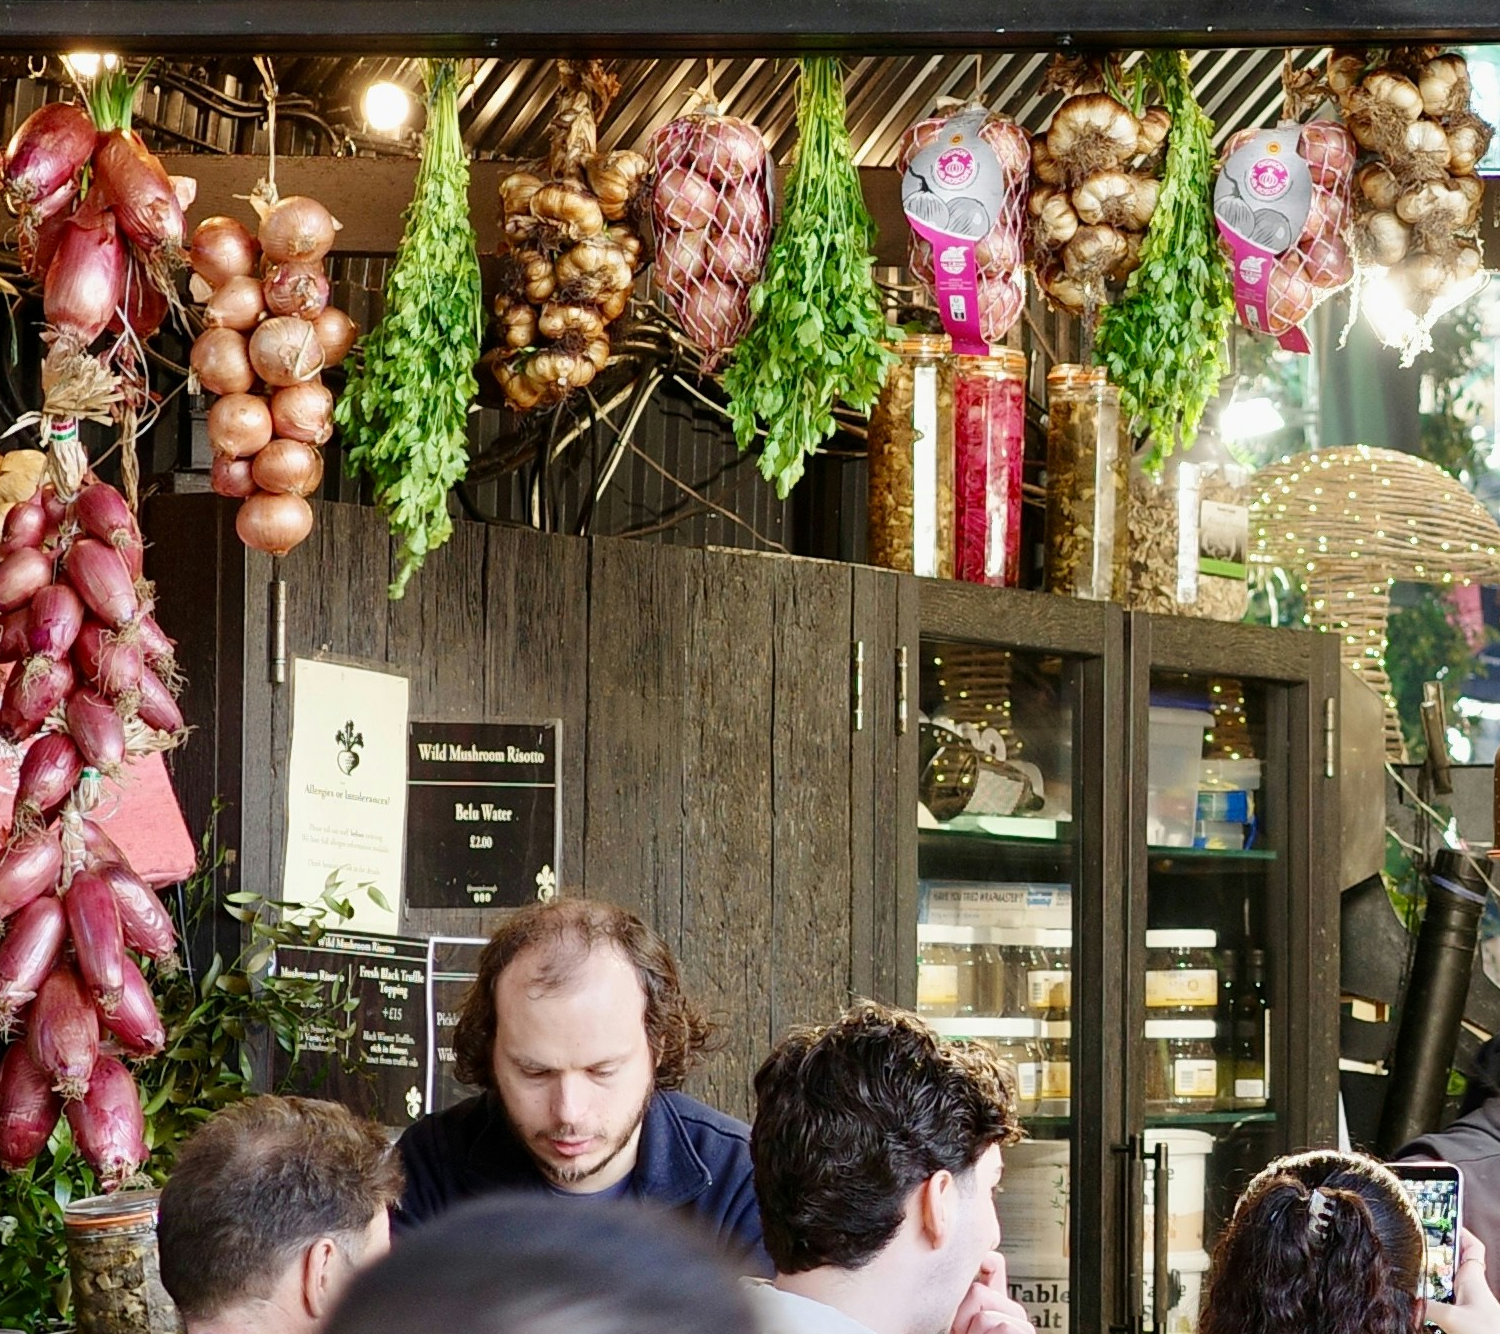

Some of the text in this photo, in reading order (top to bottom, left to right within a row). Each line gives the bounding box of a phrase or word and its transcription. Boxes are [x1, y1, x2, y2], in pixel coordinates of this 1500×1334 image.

[417, 743, 545, 764] Wild Mushroom Risotto
[305, 784, 334, 800] Allergies
[455, 802, 513, 822] Belu Water
[469, 834, 493, 849] £2.00
[360, 966, 425, 984] Fresh Black Truffle
[379, 983, 408, 999] Topping
[382, 1007, 402, 1021] +£15
